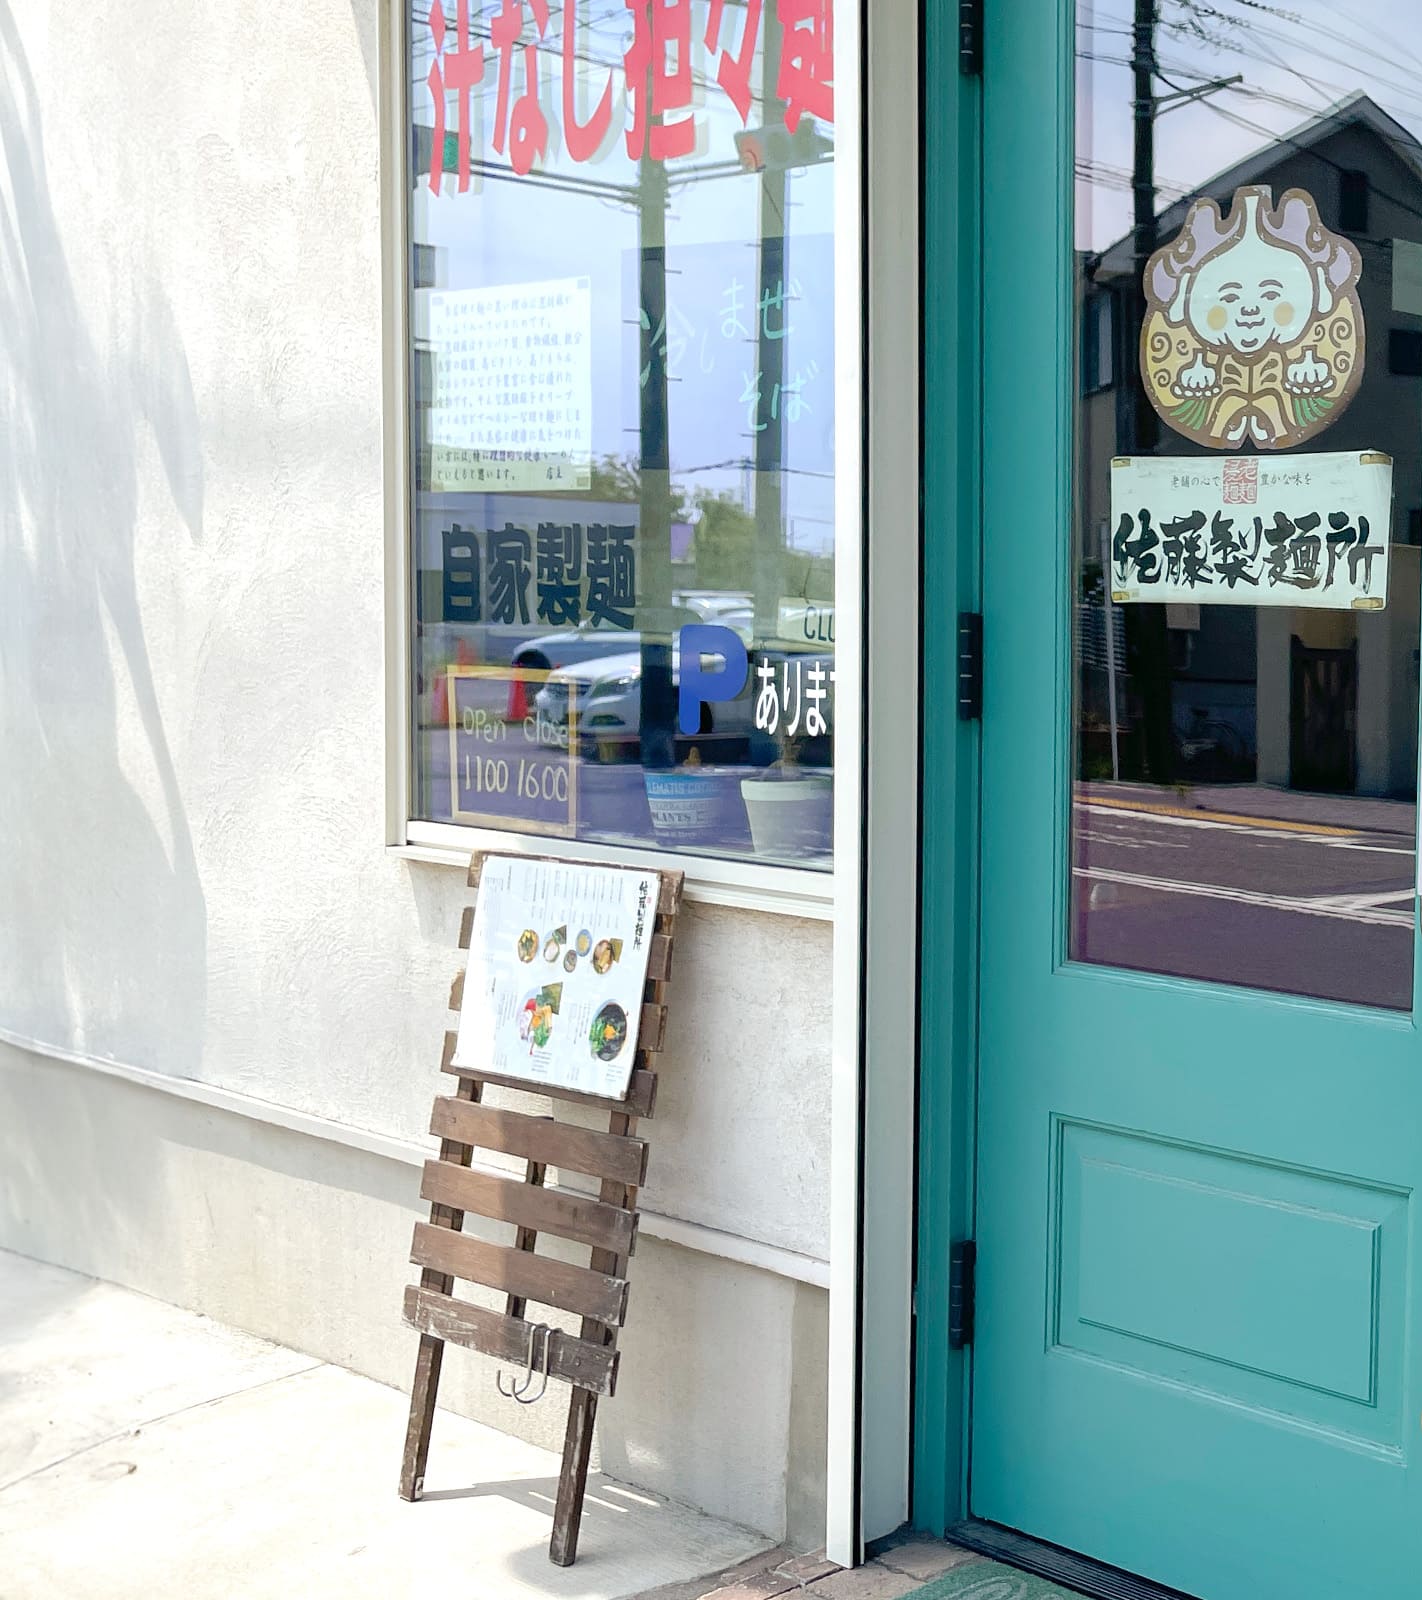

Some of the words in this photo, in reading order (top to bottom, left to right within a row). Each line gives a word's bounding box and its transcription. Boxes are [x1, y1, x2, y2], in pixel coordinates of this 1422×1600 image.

[1260, 471, 1312, 487] 豊かな味を
[442, 522, 637, 630] 自家製麺
[1113, 508, 1385, 595] 佐藤製麺所
[679, 625, 748, 735] P
[756, 657, 836, 737] ありま
[465, 754, 509, 793] 1100
[518, 758, 569, 802] 1600
